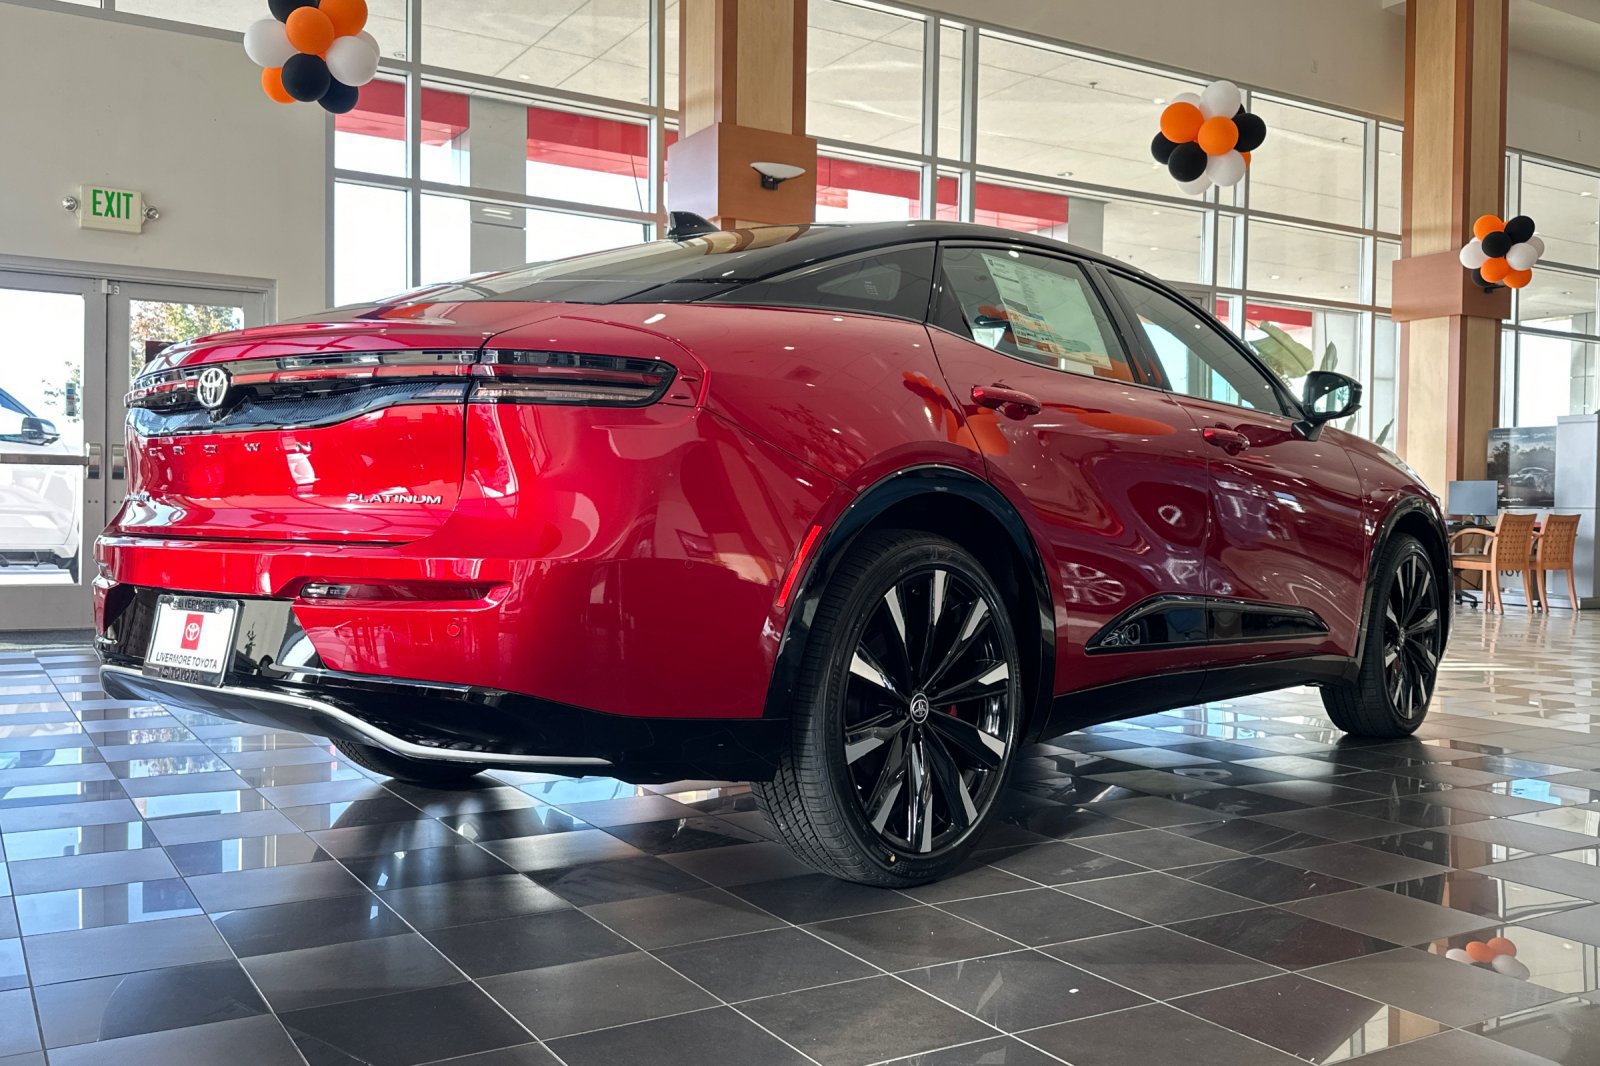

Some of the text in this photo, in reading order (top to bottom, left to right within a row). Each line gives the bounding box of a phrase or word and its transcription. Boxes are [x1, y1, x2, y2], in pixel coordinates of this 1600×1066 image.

[92, 189, 133, 220] EXIT
[346, 492, 443, 504] PLATINUM
[156, 652, 218, 669] LIVERMORE TOYOTA
[171, 667, 198, 681] TOYOTA
